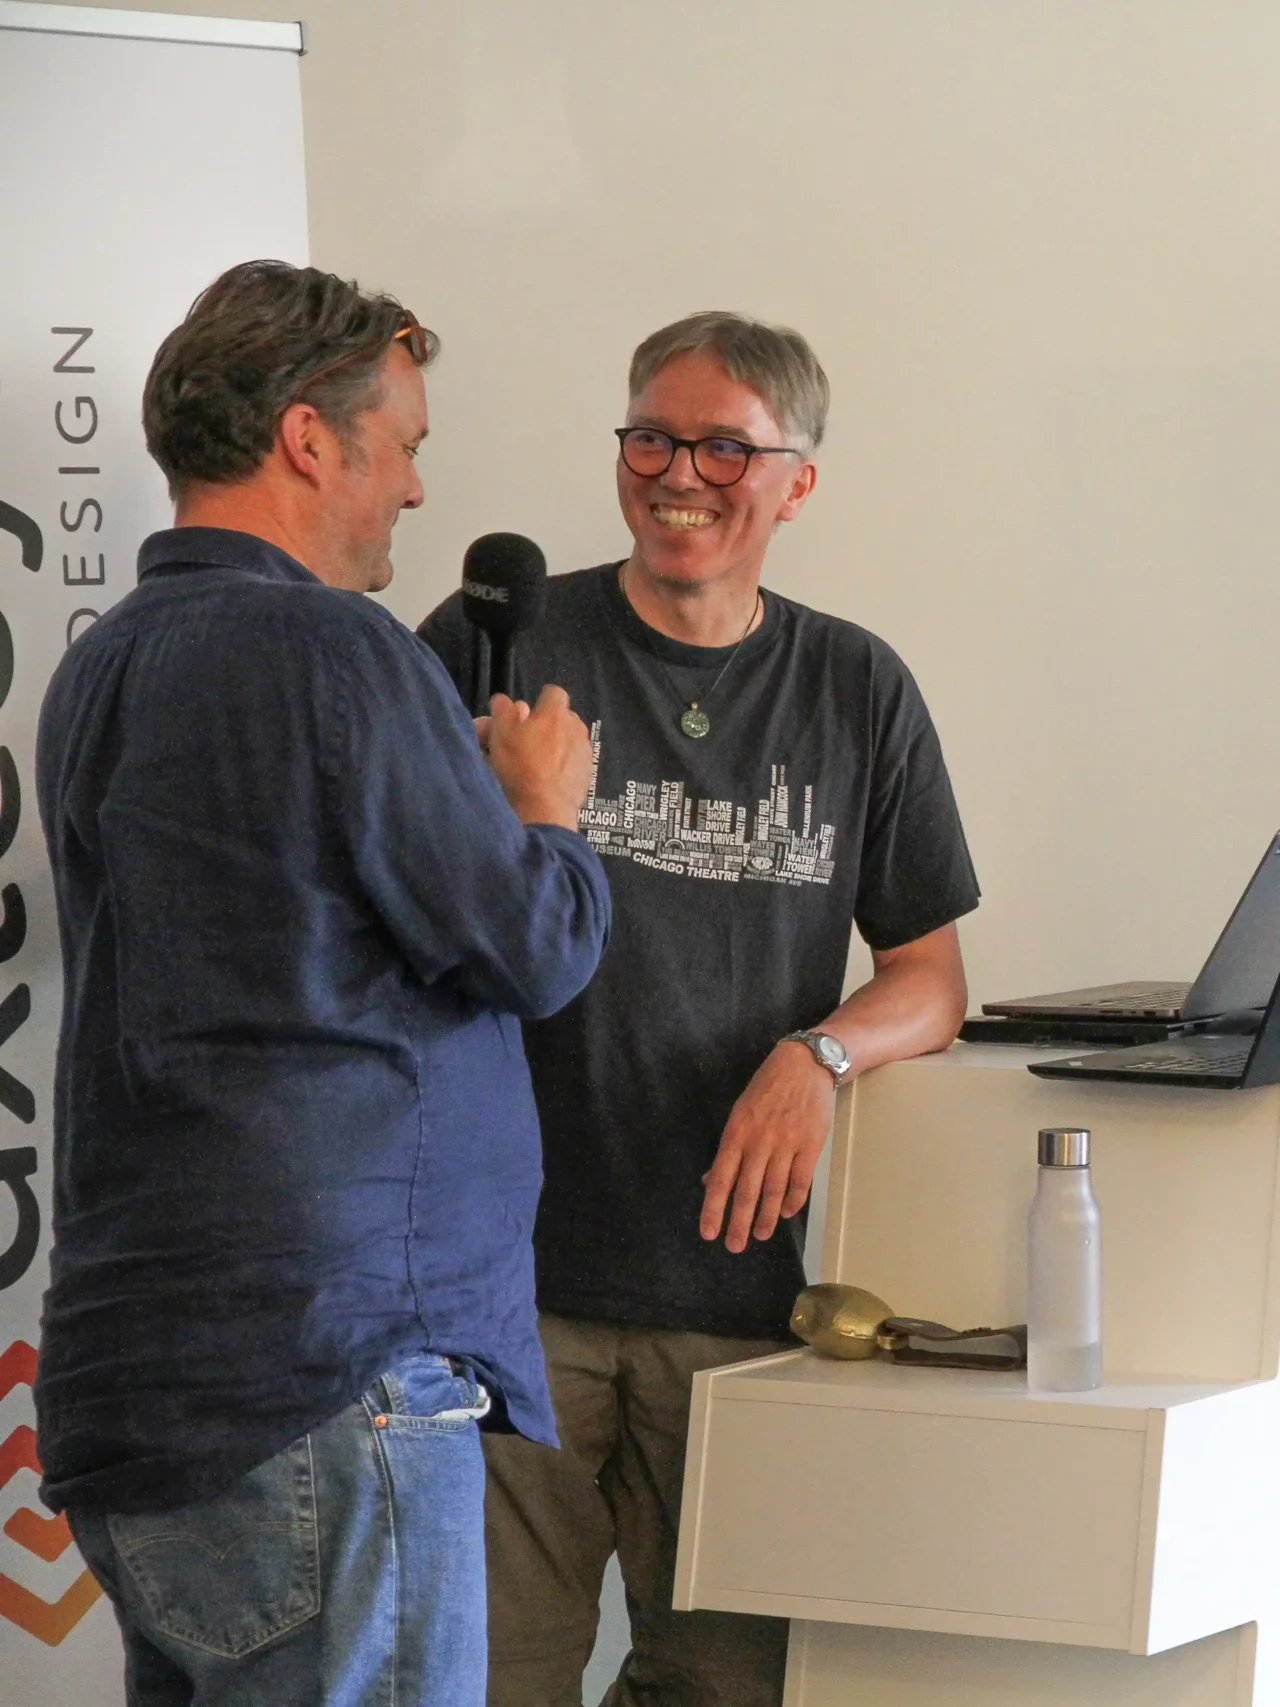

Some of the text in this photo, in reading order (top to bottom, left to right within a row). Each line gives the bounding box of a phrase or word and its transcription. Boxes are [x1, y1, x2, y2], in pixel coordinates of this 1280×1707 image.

[593, 741, 601, 763] PARK
[637, 782, 657, 796] NAVY
[669, 782, 679, 808] FIELD
[624, 780, 637, 829] CHICAGO
[636, 793, 656, 812] PIER
[660, 780, 671, 820] WRIGLEY
[707, 799, 732, 811] LAKE
[578, 809, 617, 827] HICAGO
[706, 811, 731, 821] SHORE
[737, 806, 746, 822] FIELD
[758, 799, 769, 841] WRIGLEY FIELD
[634, 817, 667, 832] CHICAGO
[706, 821, 731, 832] DRIVE
[769, 827, 791, 836] WATER
[587, 830, 610, 838] STATE
[633, 828, 666, 842] RIVER
[681, 829, 735, 846] WACKER DRIVE
[769, 835, 791, 844] TOWER
[685, 841, 742, 855] WILLIS TOWER
[750, 840, 775, 850] WATER
[794, 837, 814, 848] NAVY
[591, 843, 632, 857] USEUM
[750, 848, 775, 858] TOWER
[793, 846, 814, 857] PIER
[787, 853, 814, 864] WATER
[633, 851, 684, 875] CHICAGO
[687, 866, 740, 882] THEATRE
[787, 862, 815, 875] TOWER
[743, 873, 787, 884] MICHIGAN
[775, 870, 793, 878] LAKE
[812, 876, 830, 885] DRIVE
